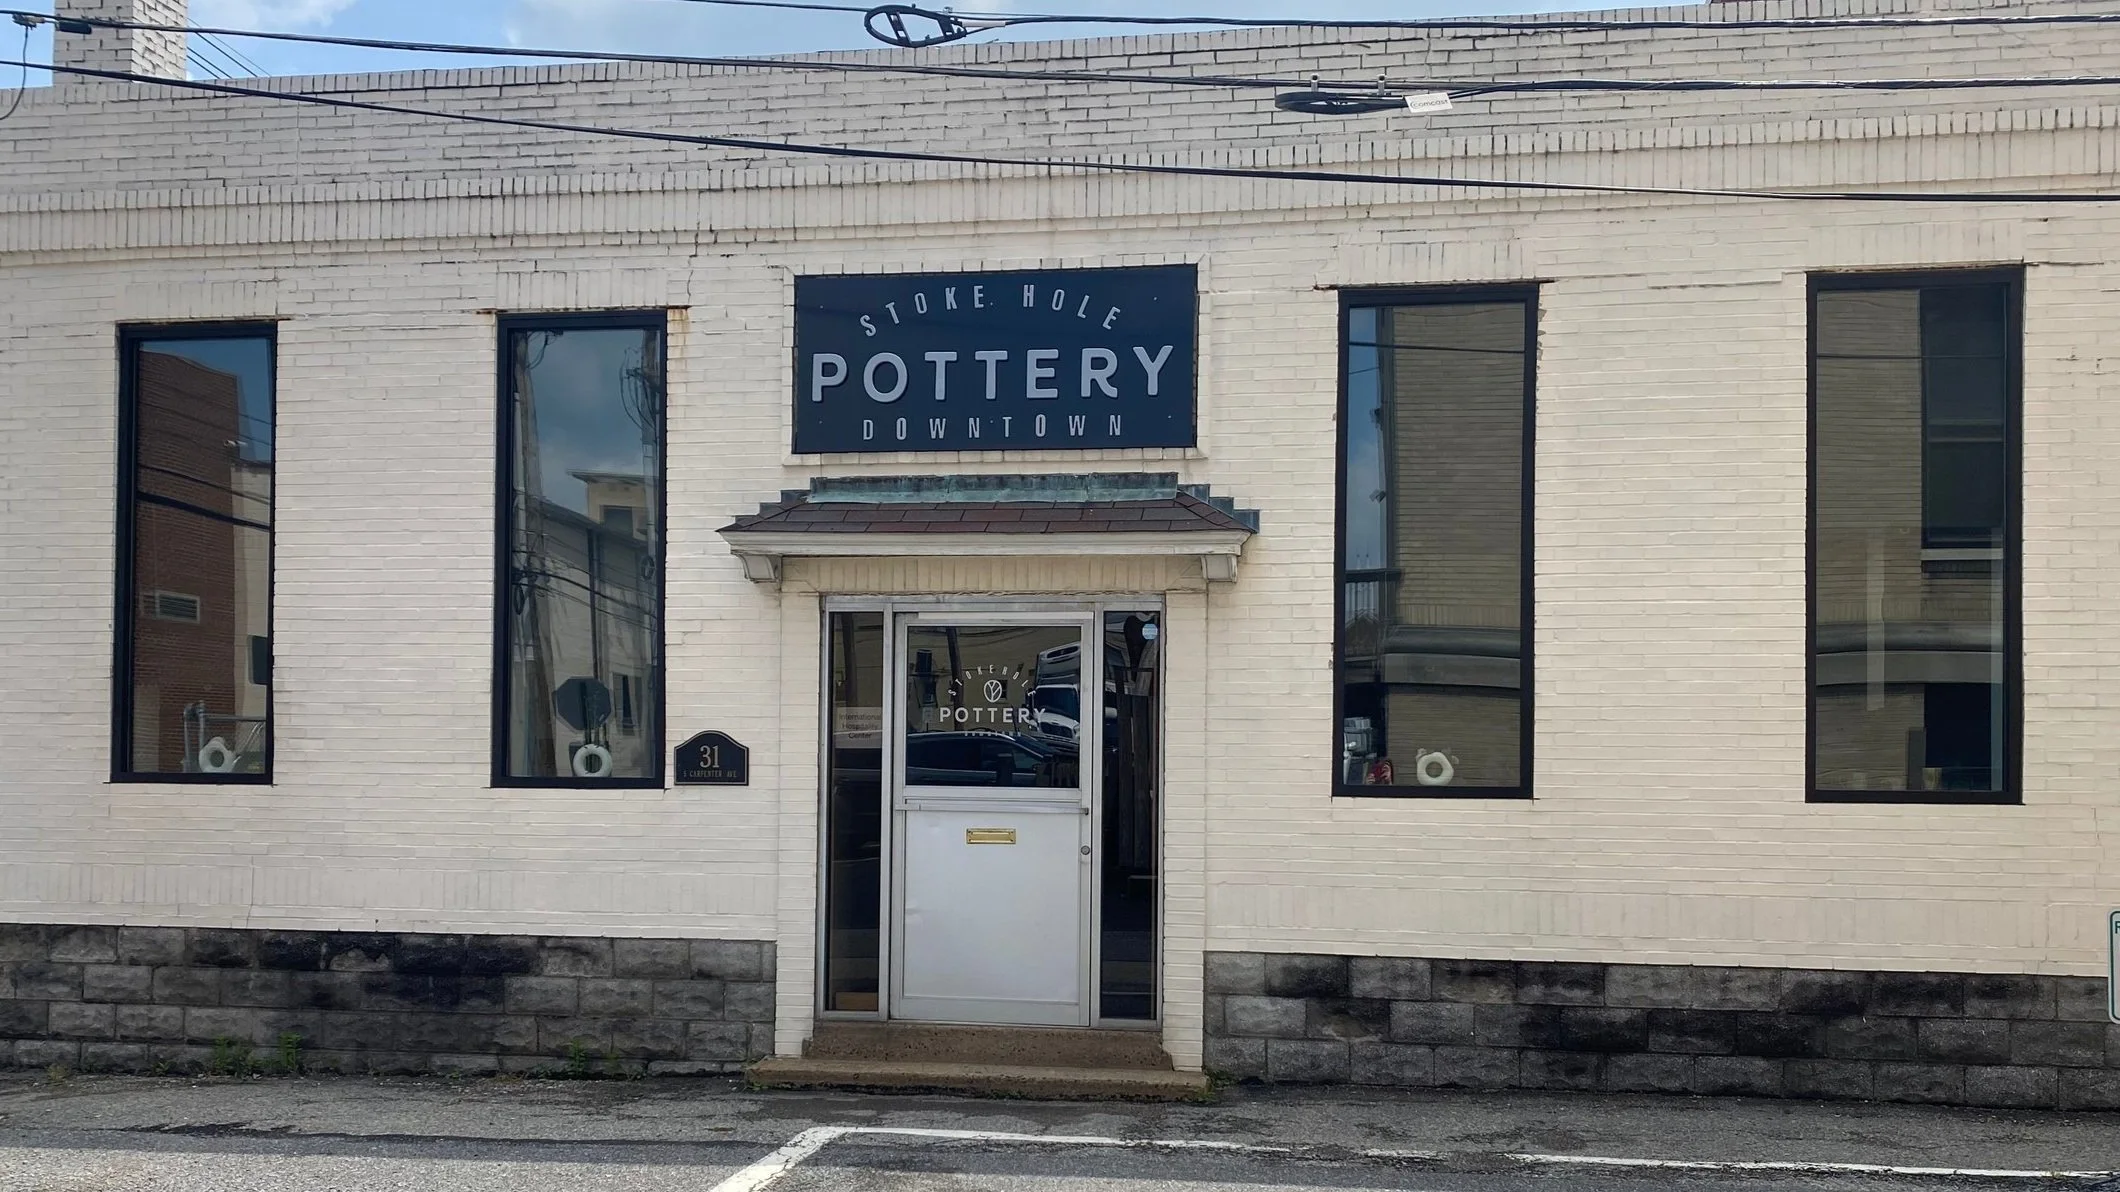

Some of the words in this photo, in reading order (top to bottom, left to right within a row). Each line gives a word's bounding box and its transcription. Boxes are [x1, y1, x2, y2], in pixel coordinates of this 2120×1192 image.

[859, 285, 985, 337] STOKE
[1022, 284, 1121, 330] HOLE
[811, 345, 1174, 402] POTTERY
[862, 414, 1122, 440] DOWNTOWN
[939, 706, 1046, 723] POTTERY
[699, 745, 720, 768] 31
